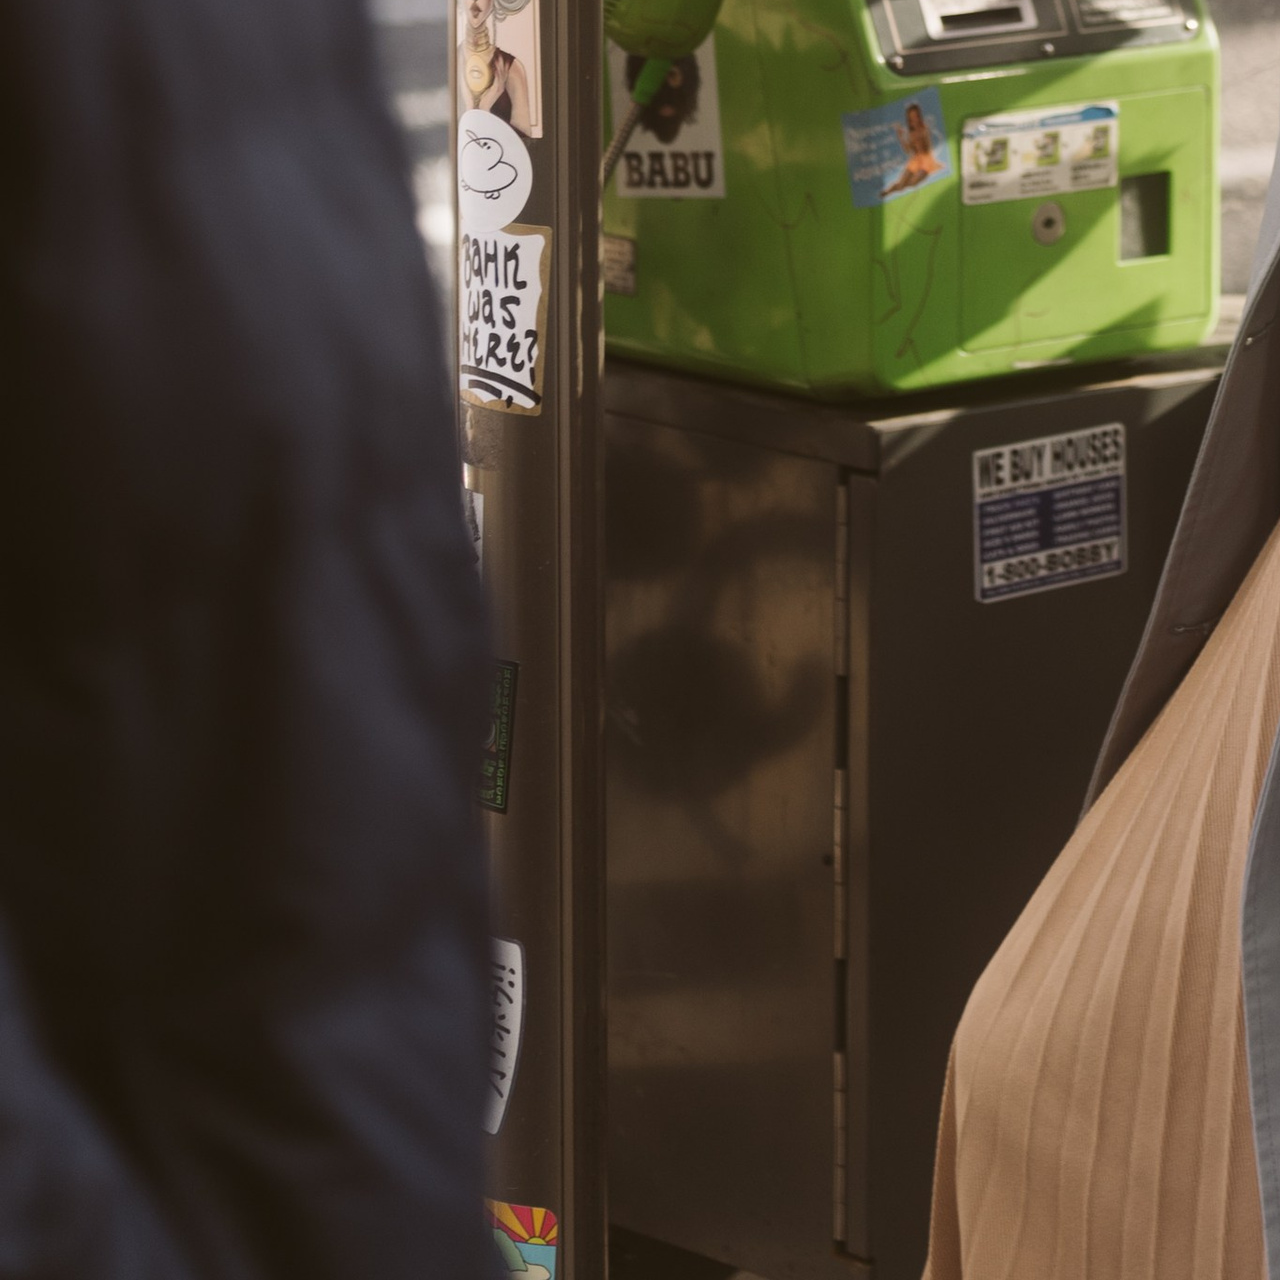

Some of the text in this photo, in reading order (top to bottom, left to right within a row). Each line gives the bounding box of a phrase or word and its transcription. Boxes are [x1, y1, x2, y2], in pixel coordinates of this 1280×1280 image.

[624, 150, 715, 189] BABU
[1010, 444, 1046, 483] BUY
[1051, 428, 1121, 474] HOUSES
